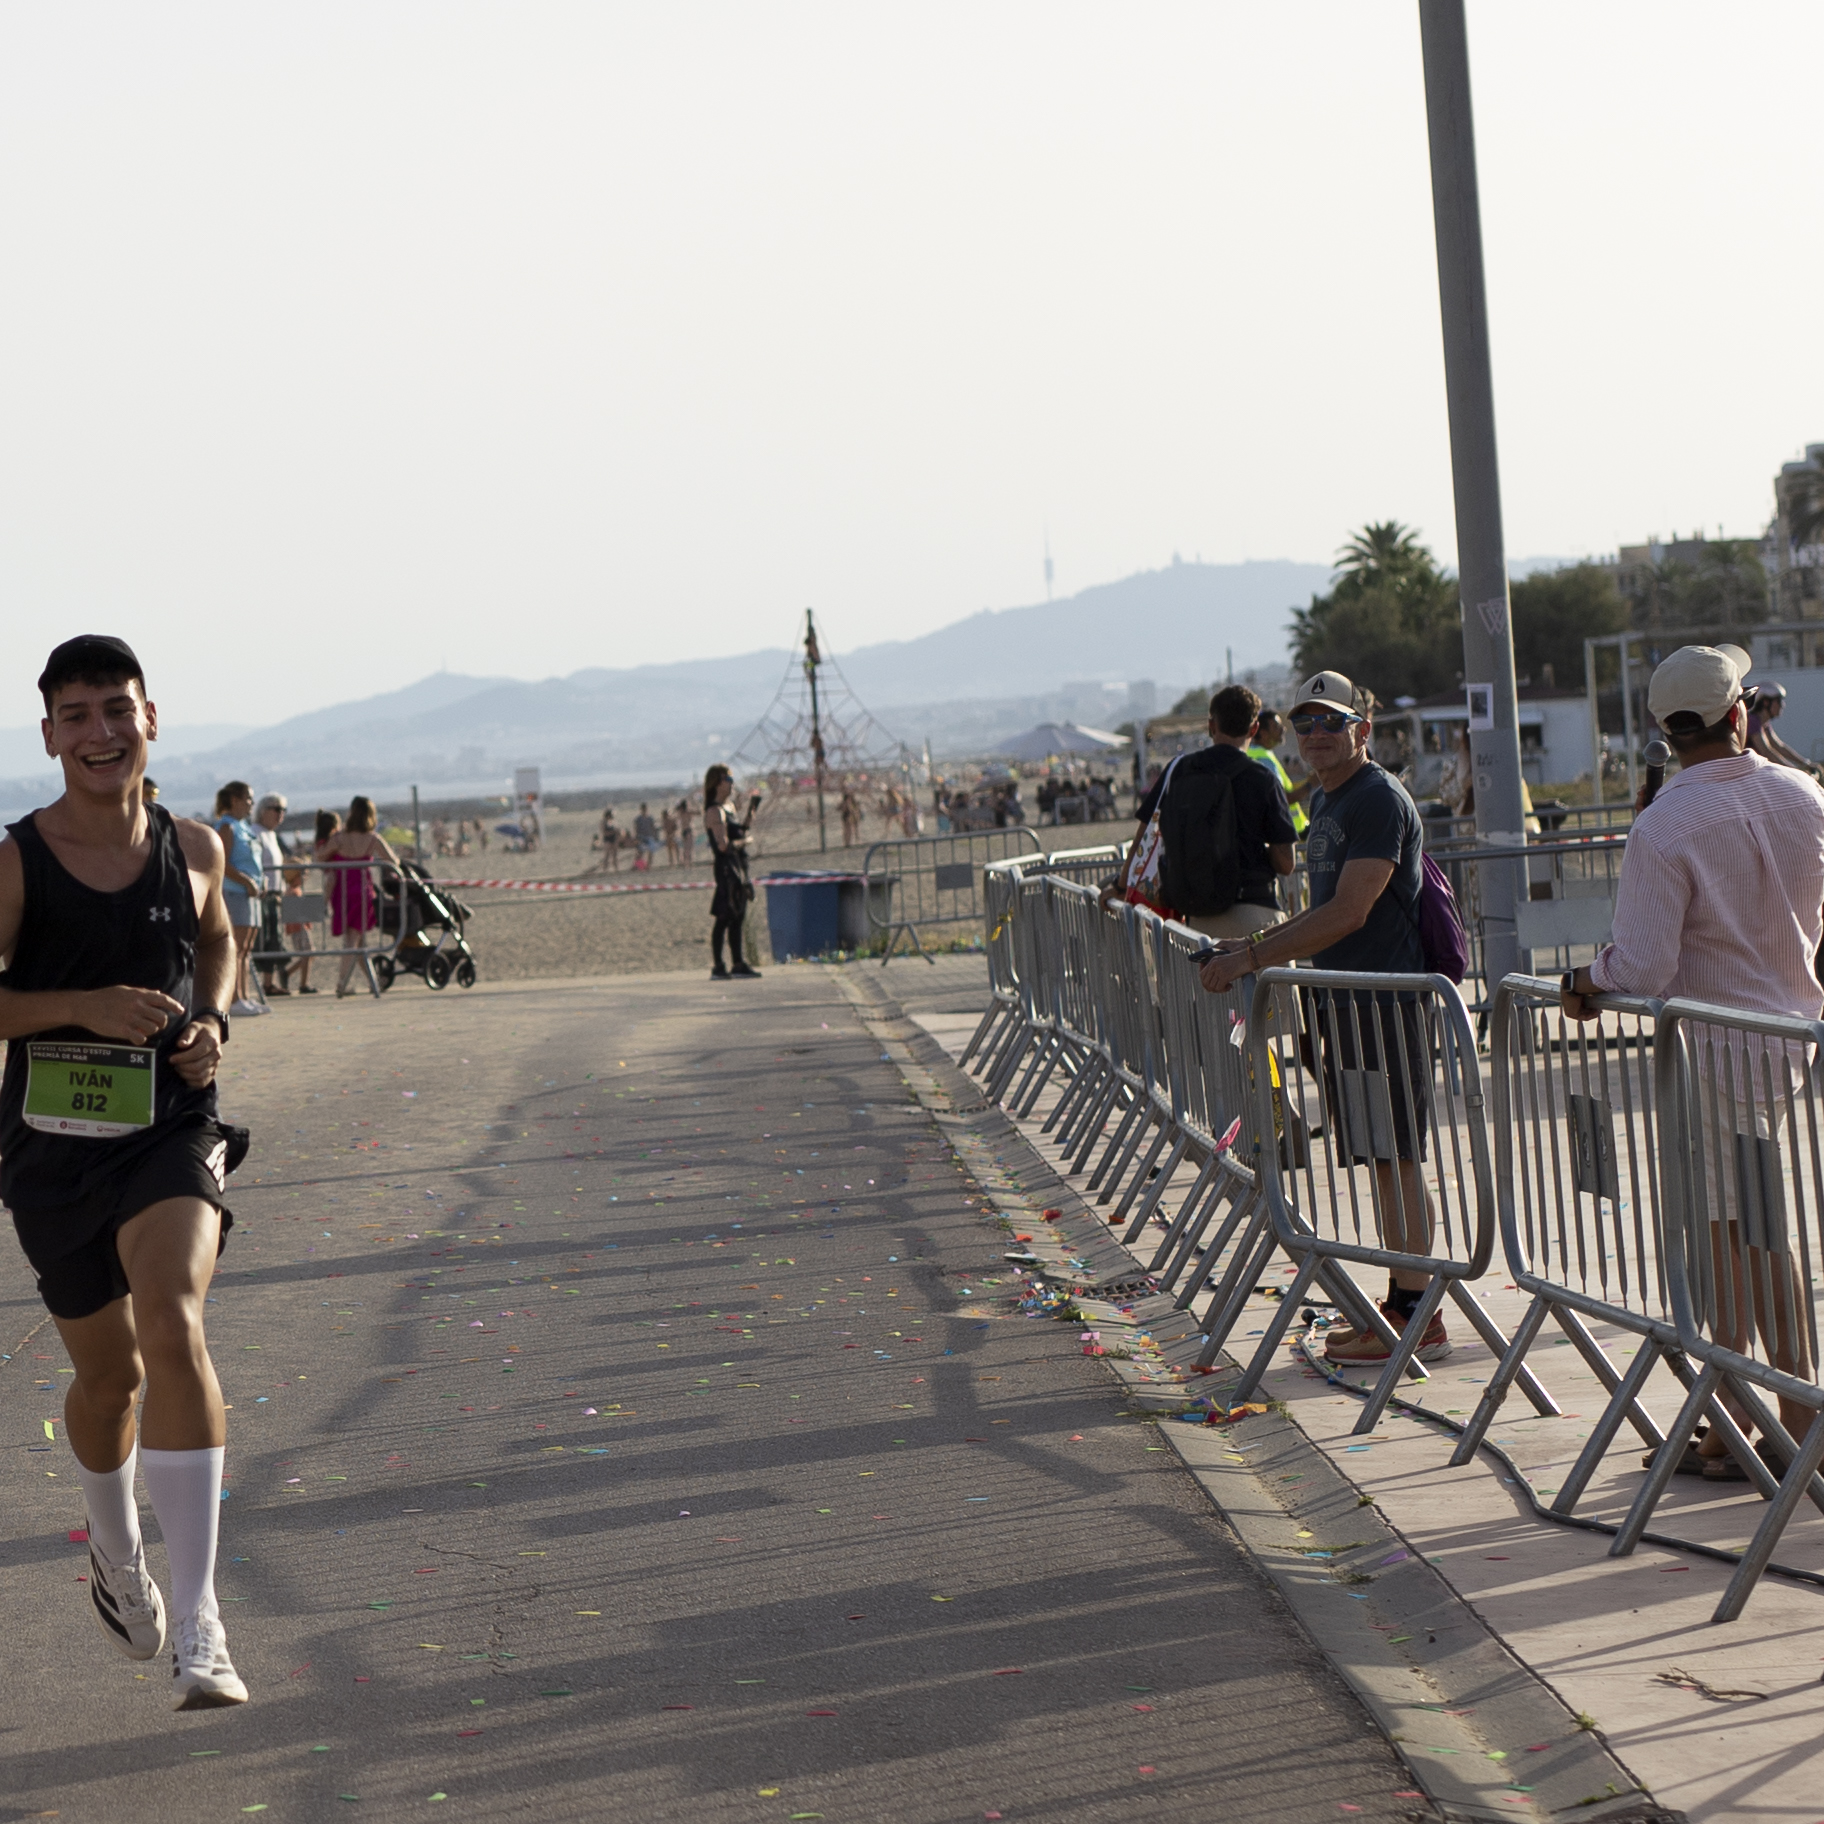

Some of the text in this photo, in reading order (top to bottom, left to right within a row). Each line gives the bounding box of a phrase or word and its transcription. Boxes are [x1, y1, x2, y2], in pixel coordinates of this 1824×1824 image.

[129, 1053, 145, 1064] 5K
[69, 1069, 113, 1089] IVÁN
[71, 1092, 108, 1113] 812
